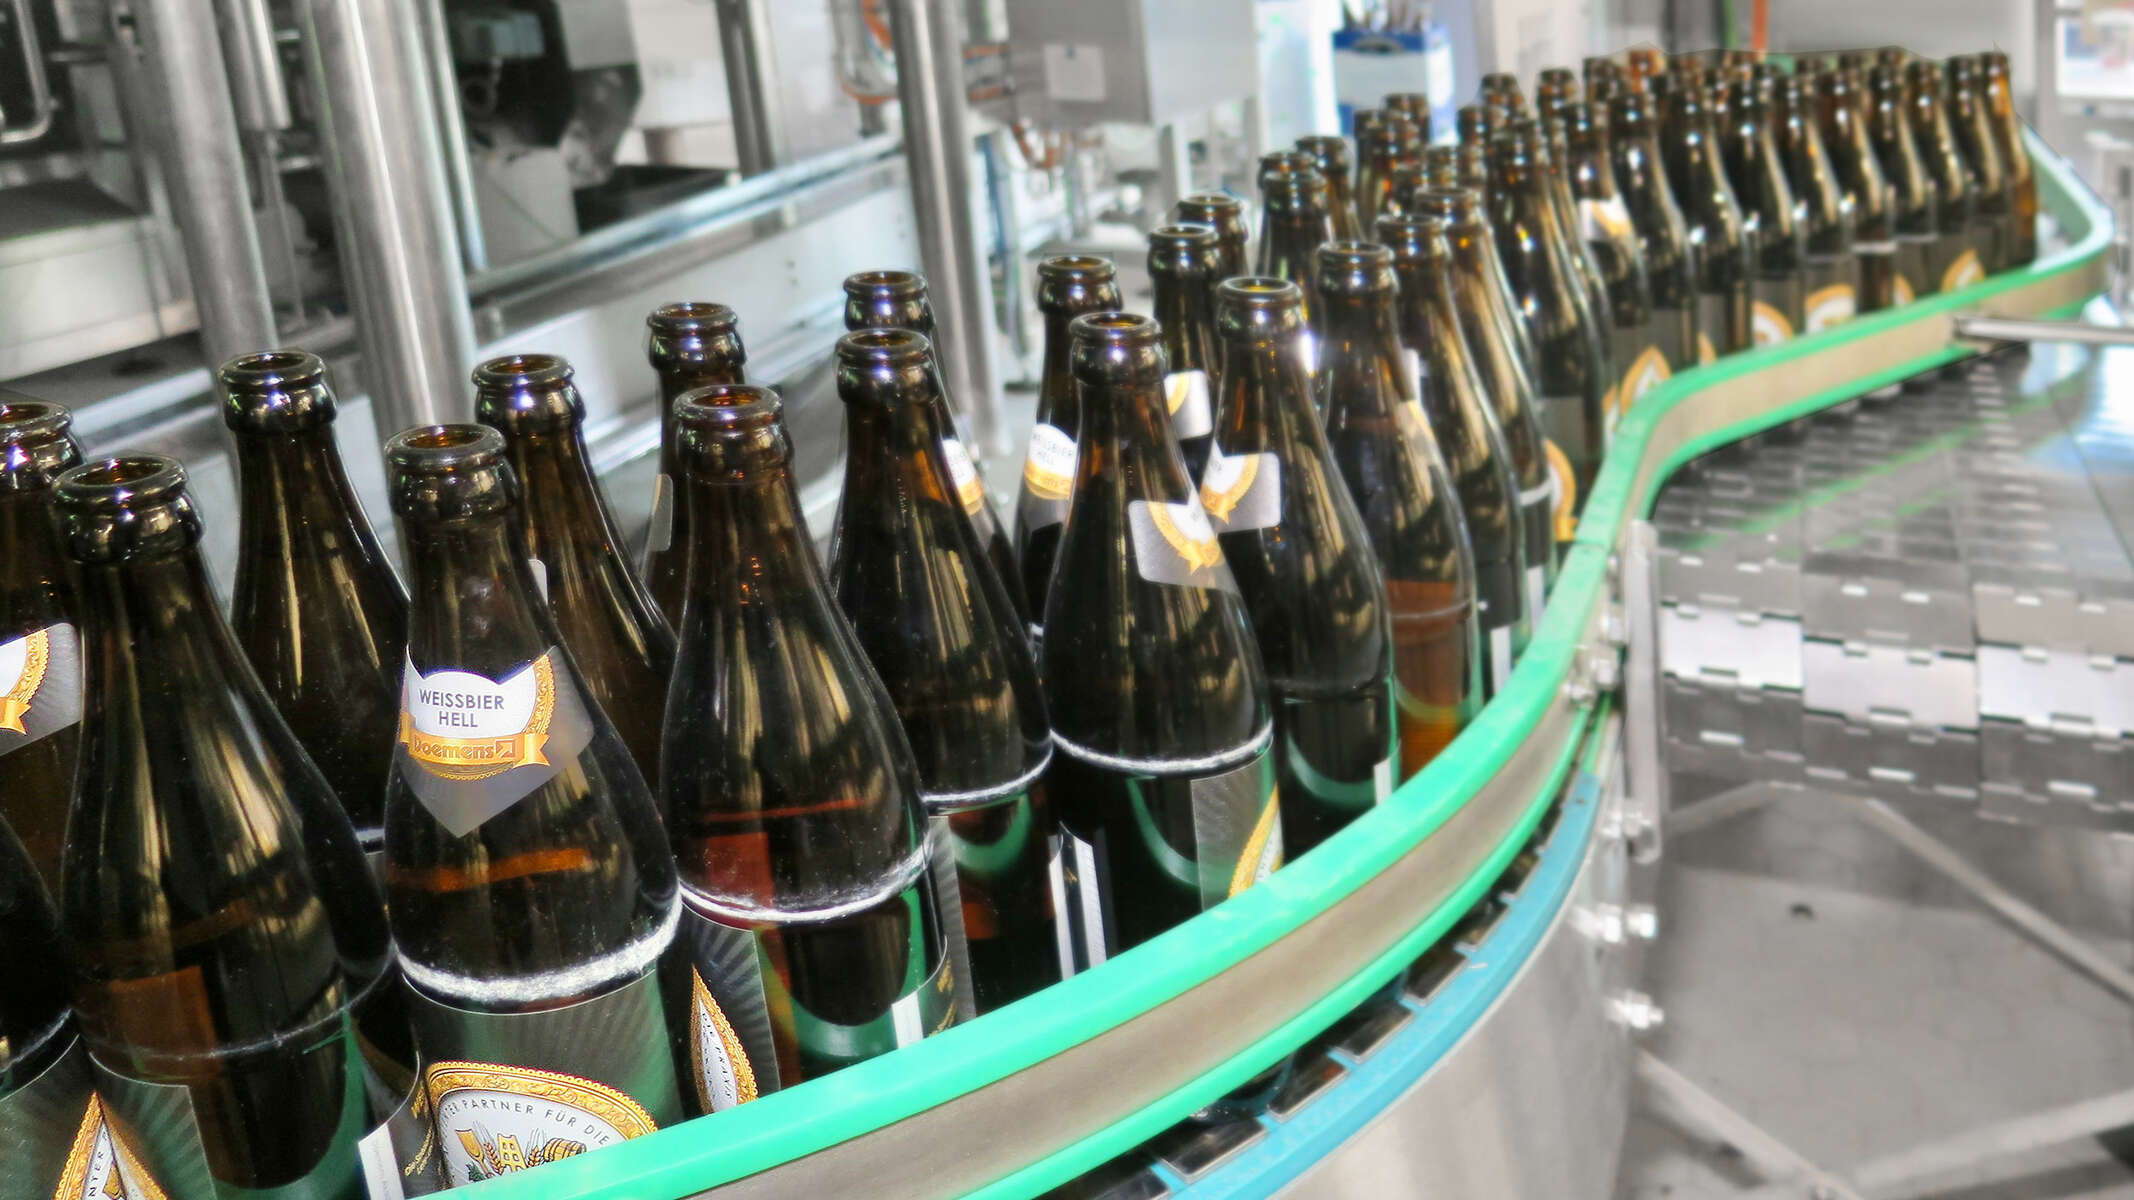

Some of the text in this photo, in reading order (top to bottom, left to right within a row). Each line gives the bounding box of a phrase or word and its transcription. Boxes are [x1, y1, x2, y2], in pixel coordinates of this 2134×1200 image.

[420, 688, 504, 710] WEISSBIER
[439, 711, 478, 727] HELL
[462, 1099, 610, 1145] PARTNER FÜR DIE
